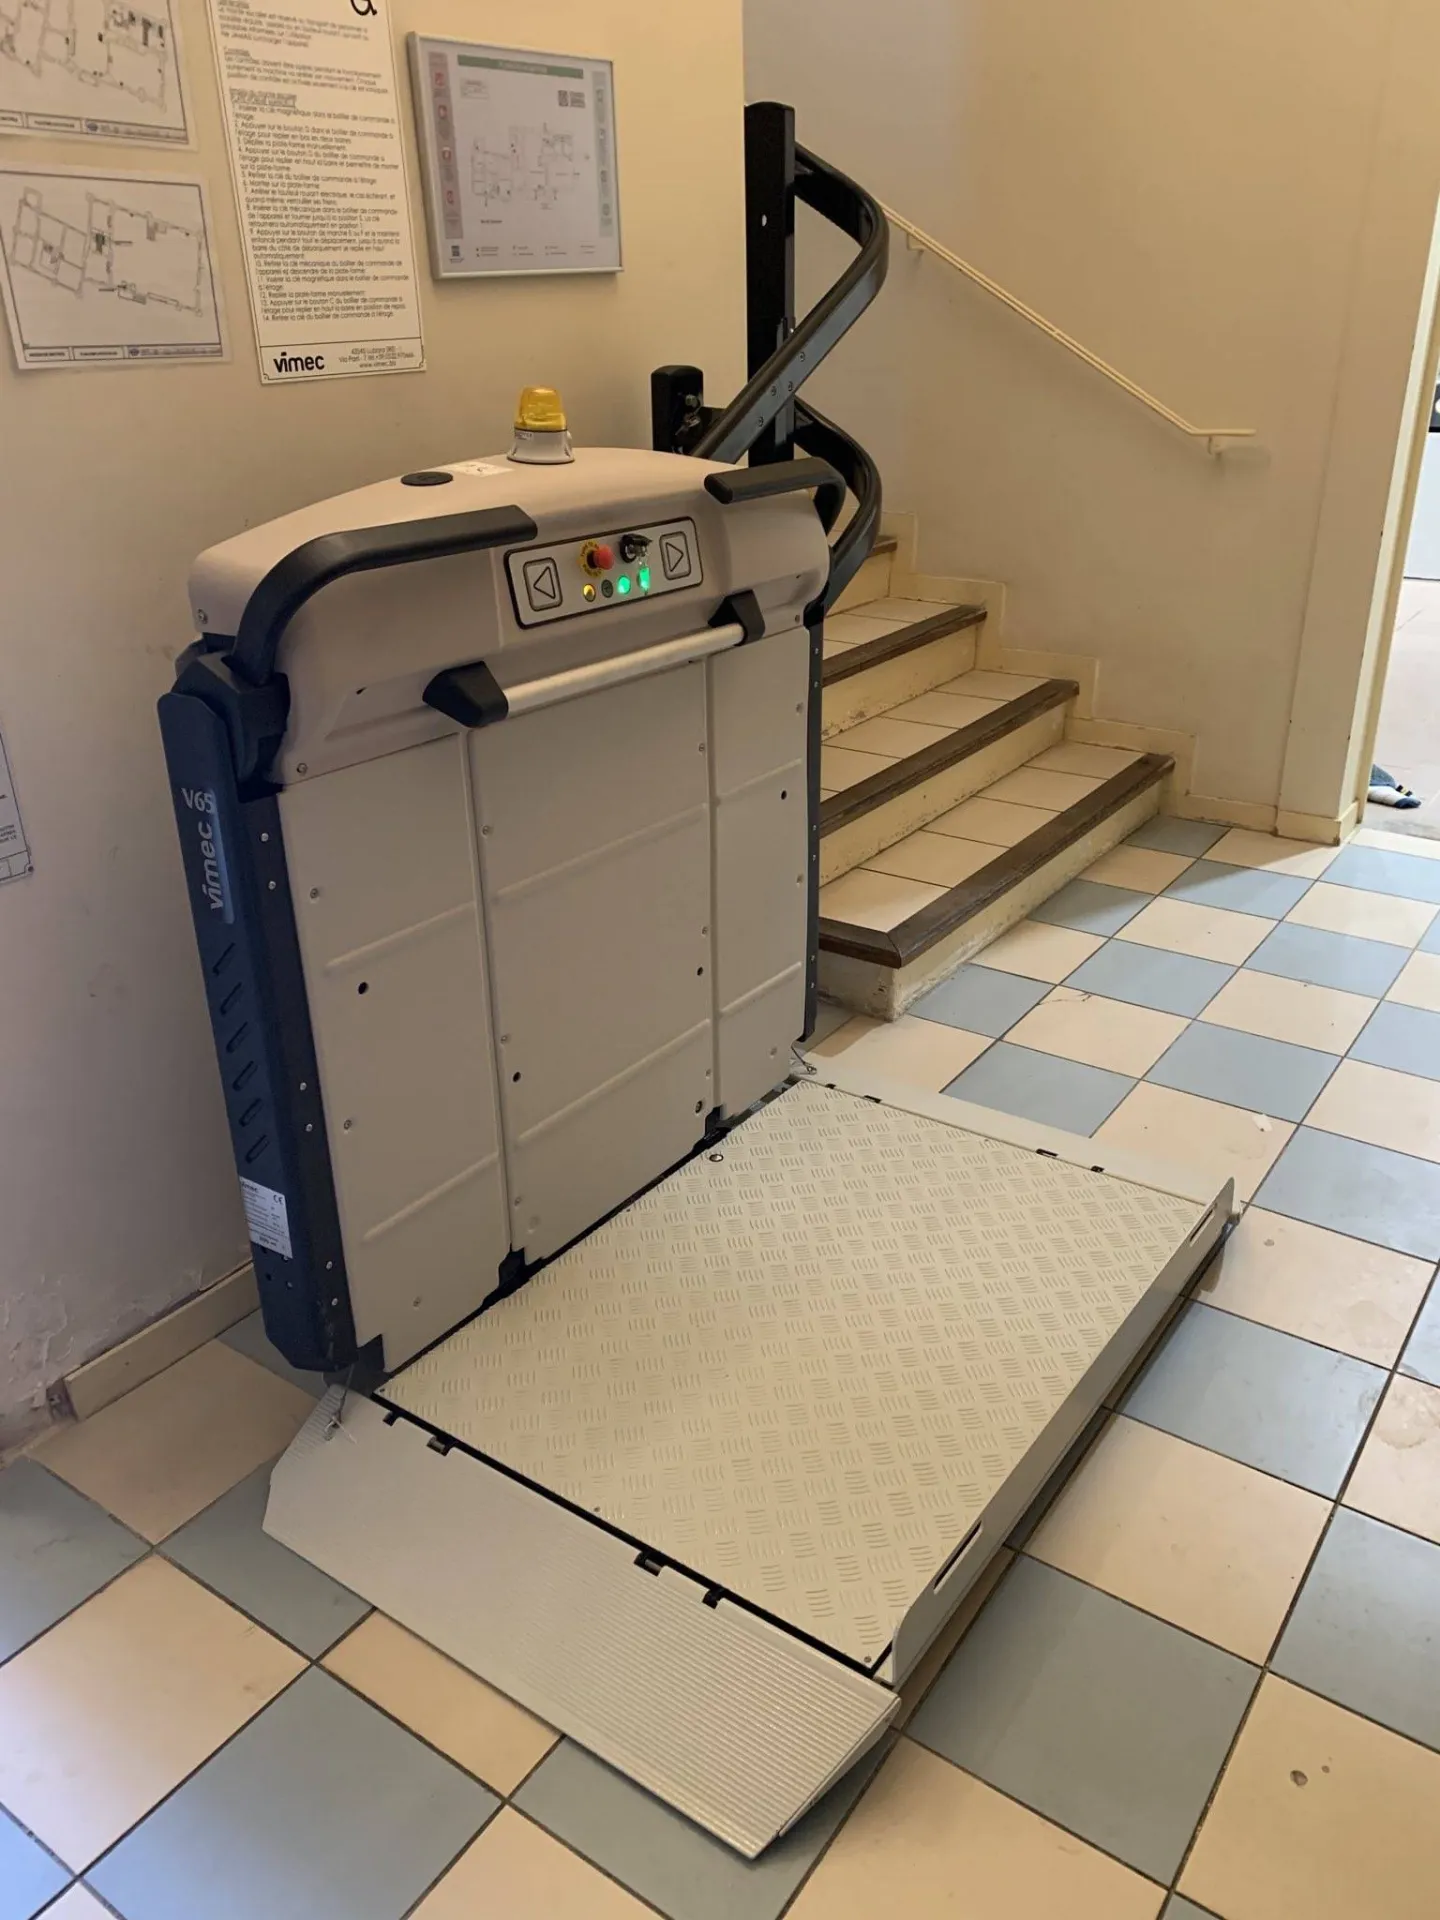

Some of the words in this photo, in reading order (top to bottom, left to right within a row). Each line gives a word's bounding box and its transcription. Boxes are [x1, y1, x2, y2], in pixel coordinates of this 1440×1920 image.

[273, 352, 325, 373] vimec
[181, 787, 216, 814] V65
[198, 821, 224, 911] vimec
